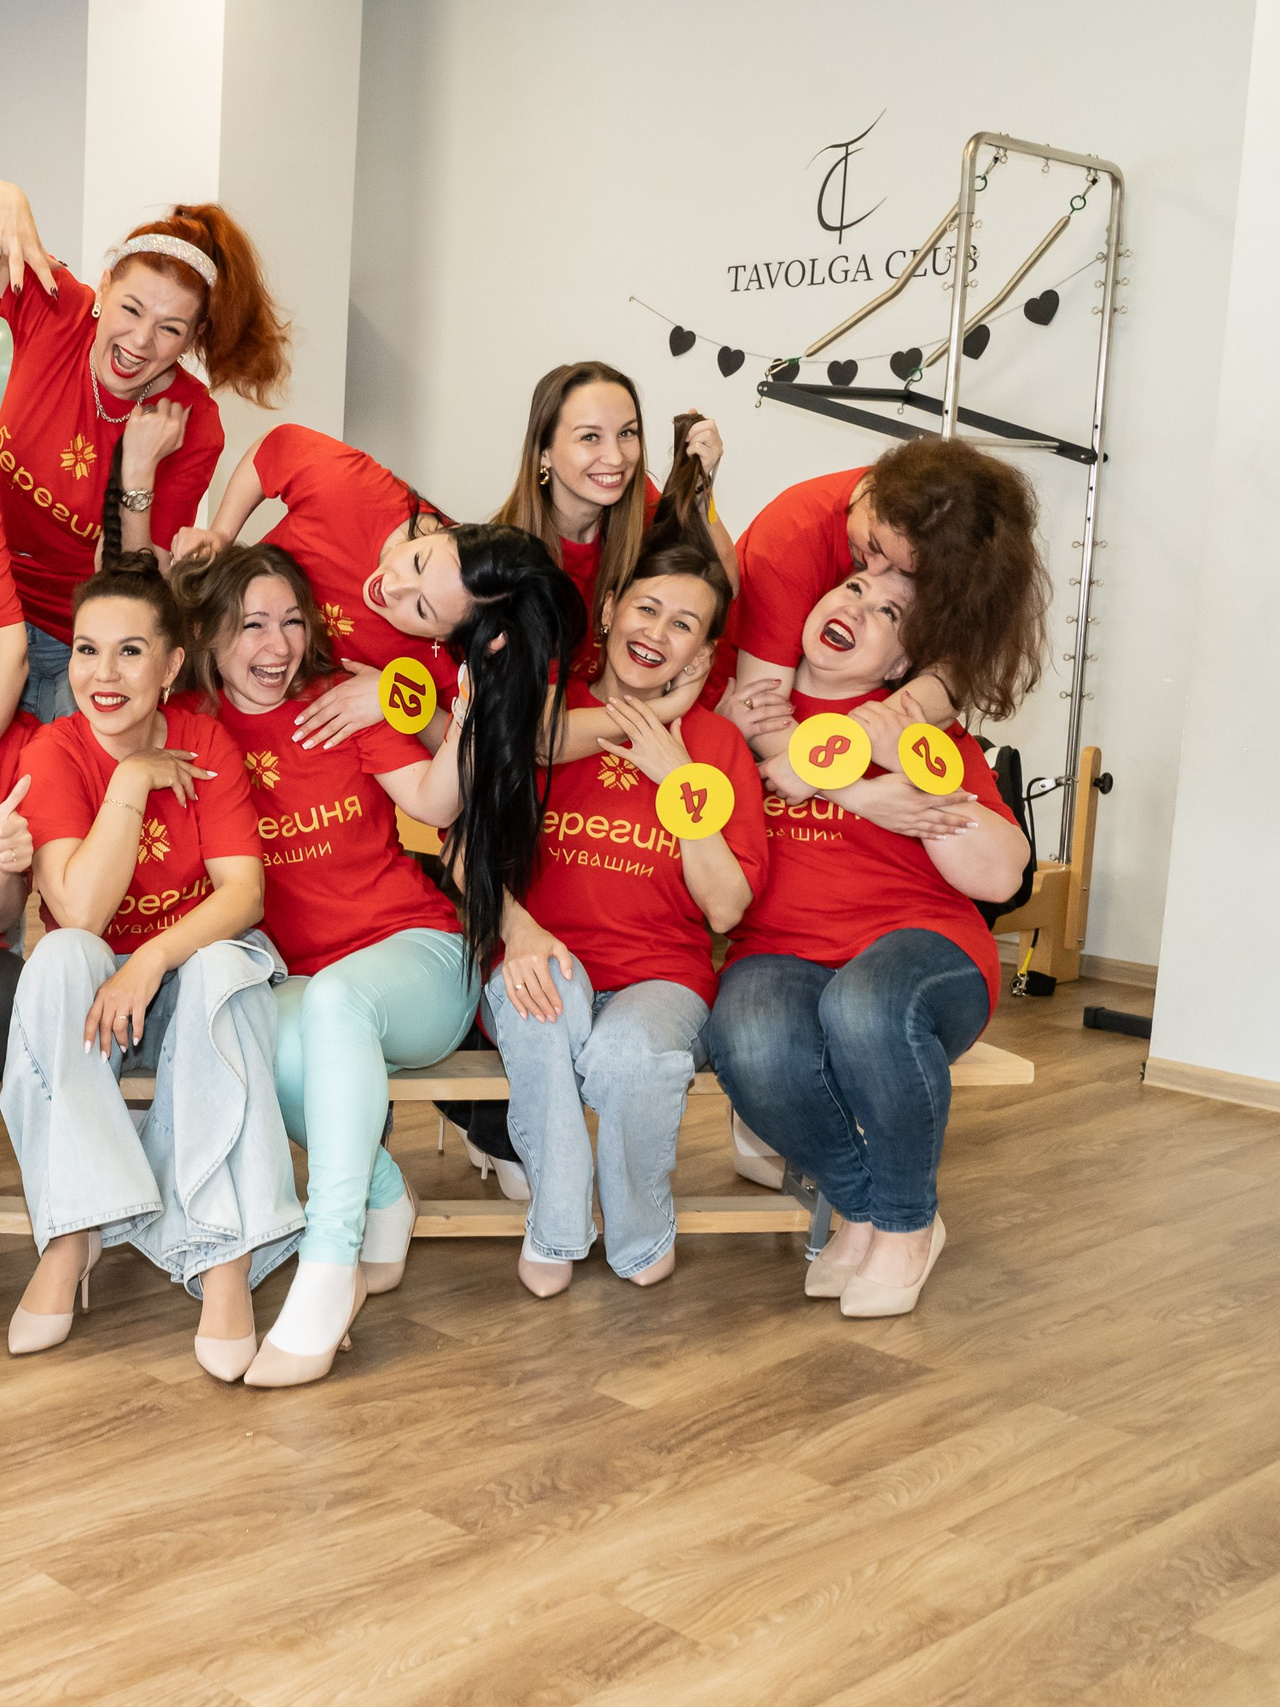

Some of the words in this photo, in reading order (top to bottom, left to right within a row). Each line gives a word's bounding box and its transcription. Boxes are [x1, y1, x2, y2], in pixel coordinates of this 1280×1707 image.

[727, 254, 874, 292] TAVOLGA
[389, 672, 426, 717] 12
[808, 735, 851, 768] 8
[911, 736, 947, 778] 2
[257, 795, 363, 839] егиня
[679, 781, 708, 824] 4
[543, 810, 681, 860] ерегин
[548, 846, 655, 878] чувашии
